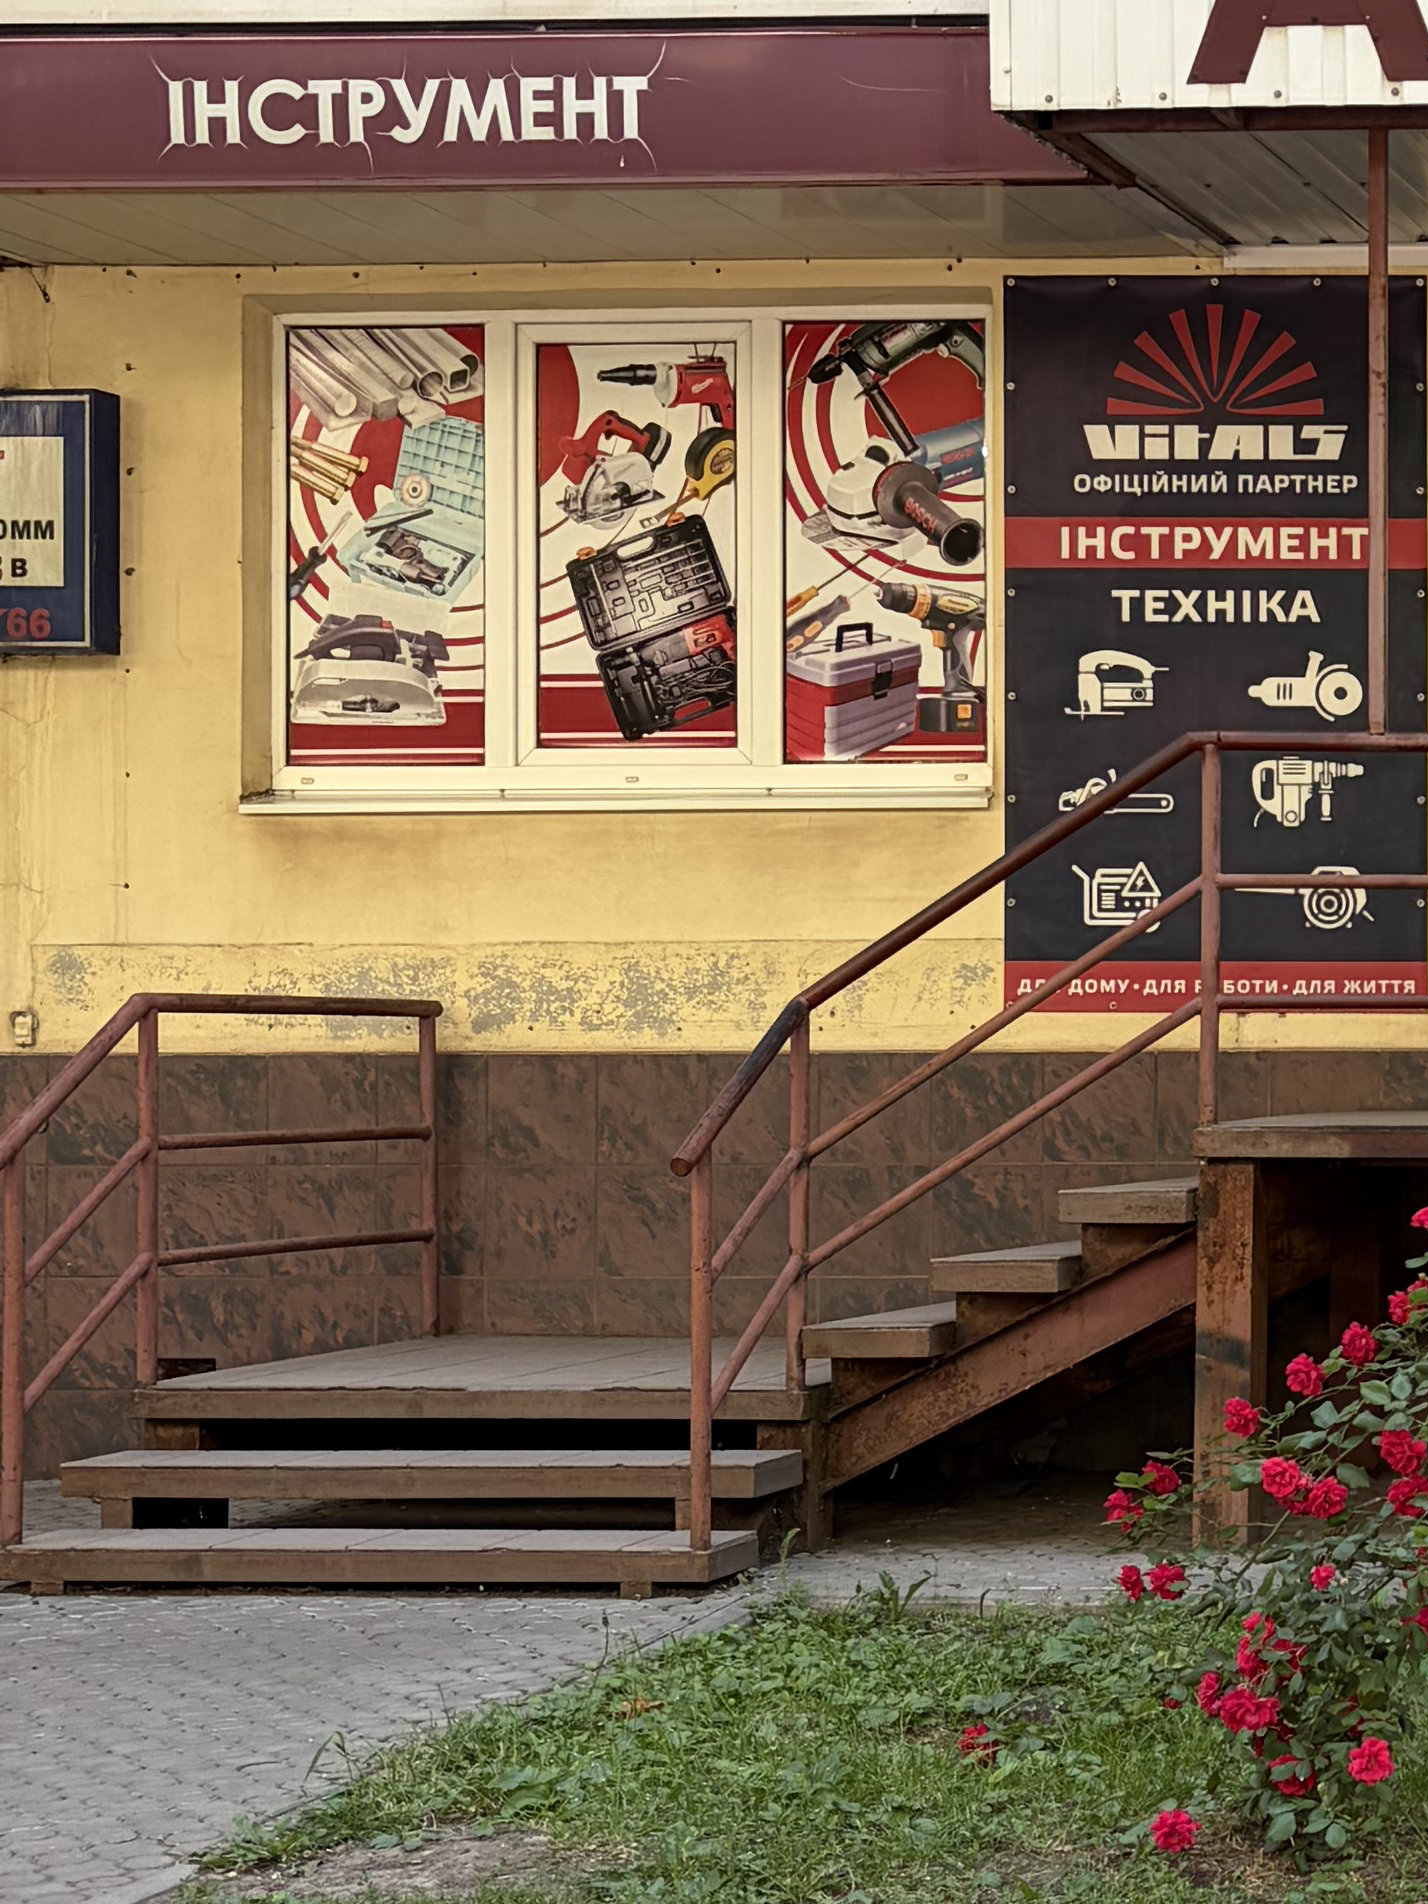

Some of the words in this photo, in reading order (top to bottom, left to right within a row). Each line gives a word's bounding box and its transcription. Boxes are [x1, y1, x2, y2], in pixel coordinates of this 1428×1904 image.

[169, 72, 651, 147] ІНСТРУМЕНТ
[1073, 470, 1228, 497] ОФІЦІЙНИЙ
[1237, 474, 1358, 494] ПАРТНЕР
[1060, 525, 1369, 561] ІНСТРУМЕНТ
[1111, 589, 1322, 623] ТЕХНІКА
[1068, 978, 1130, 997] ДОМУ
[1143, 979, 1186, 997] ДЛЯ
[1194, 979, 1279, 994] РБОТИ
[1292, 979, 1336, 996] ДЛЯ
[1343, 979, 1417, 995] ЖИТТЯ
